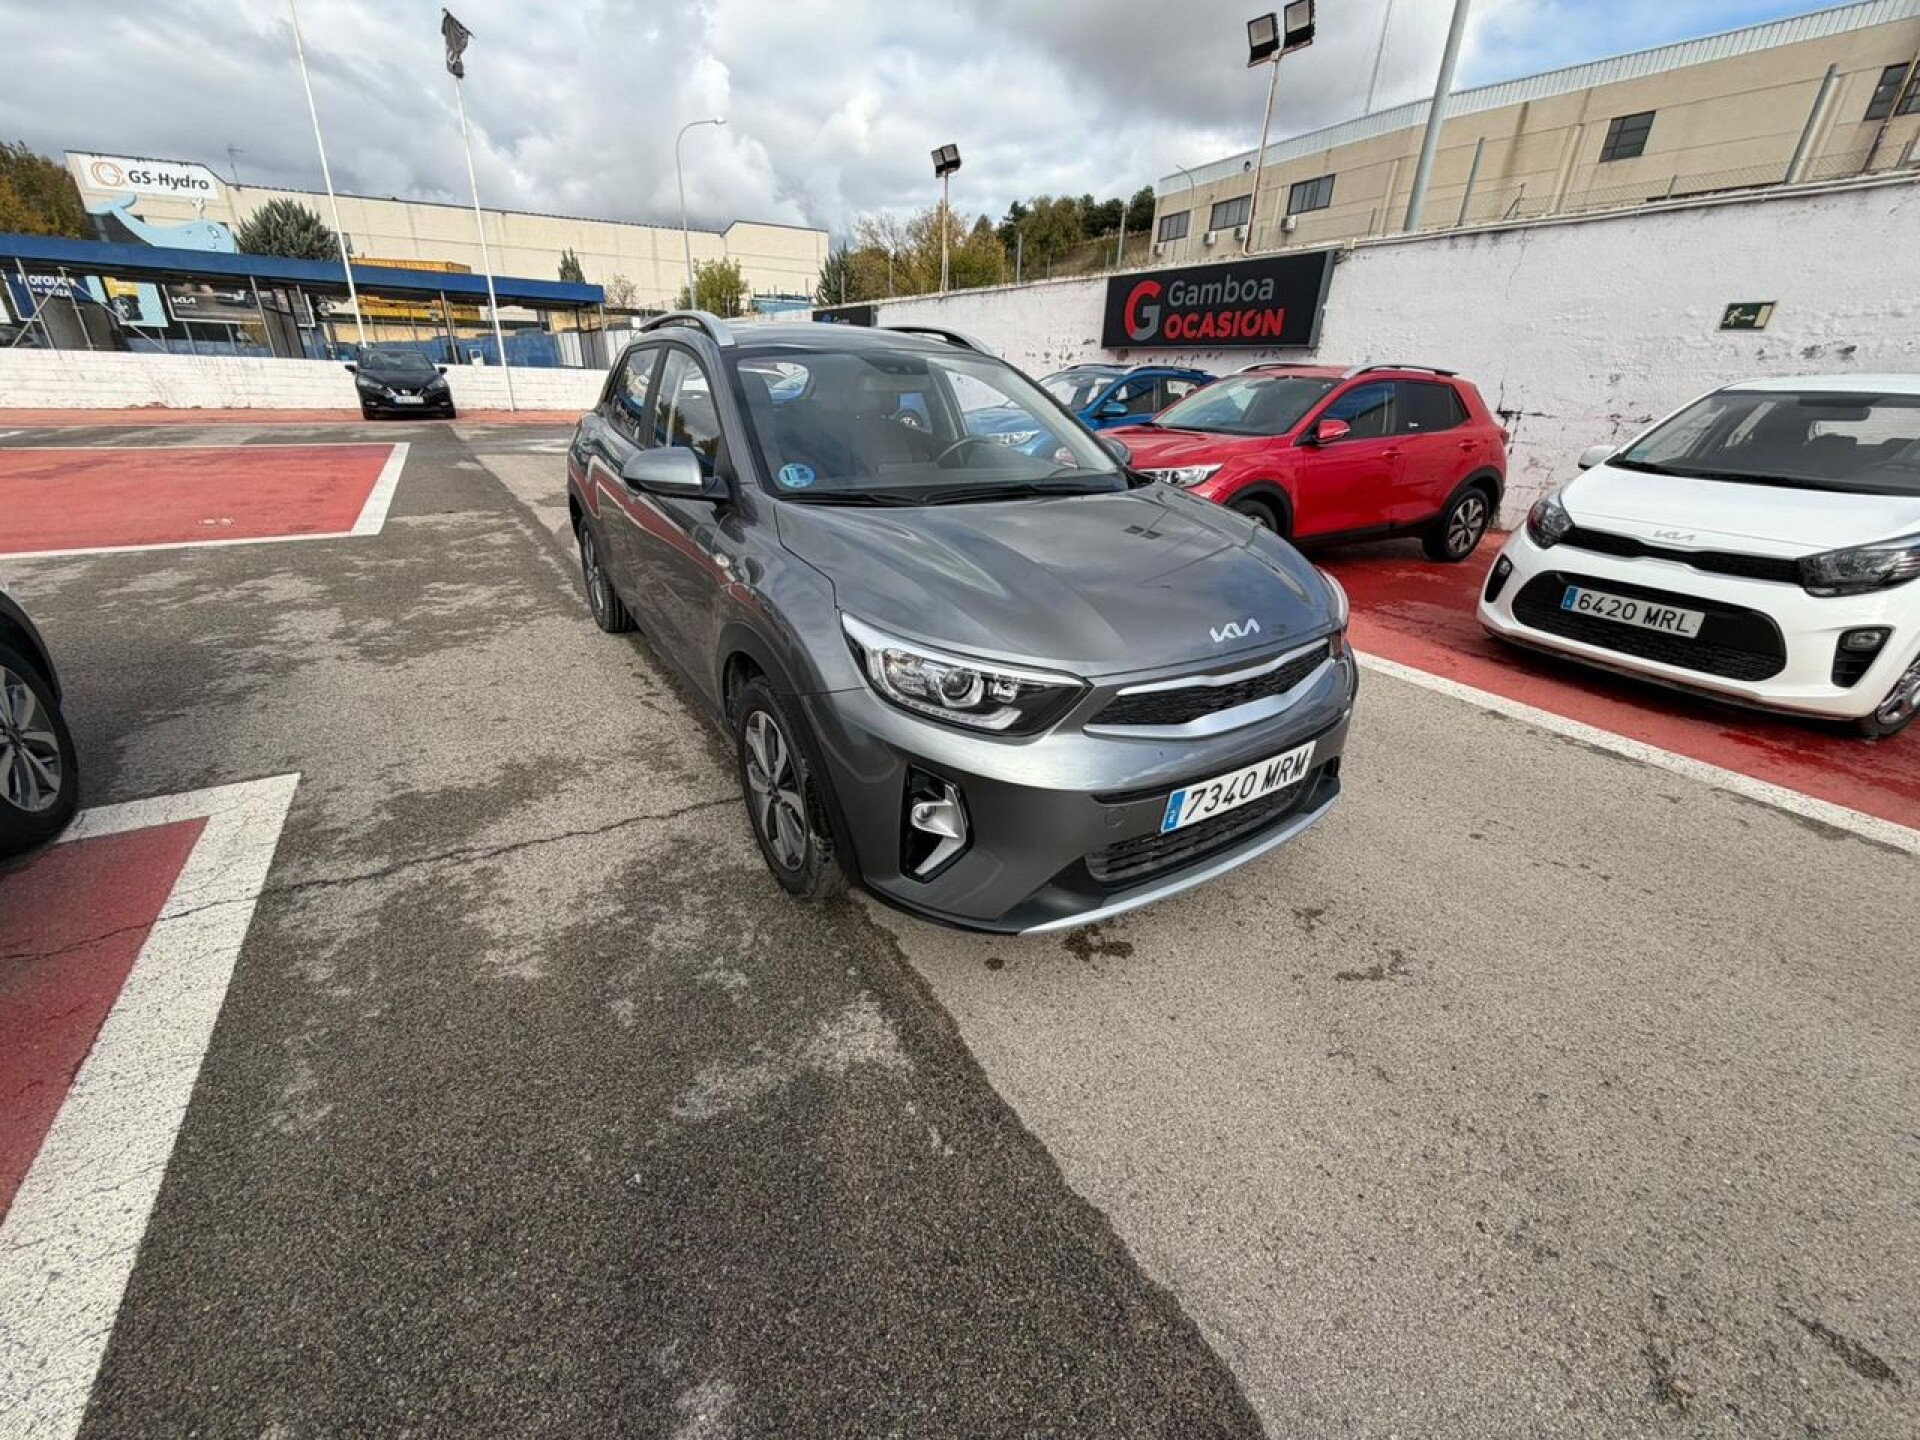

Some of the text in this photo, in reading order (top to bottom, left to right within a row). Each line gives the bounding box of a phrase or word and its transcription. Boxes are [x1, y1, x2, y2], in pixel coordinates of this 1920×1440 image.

[128, 170, 210, 191] GS-Hydro
[1168, 274, 1275, 307] Gamboa
[1578, 593, 1690, 633] 6420 MRL
[1210, 618, 1260, 642] KIA
[1184, 748, 1309, 820] 7340 MRM
